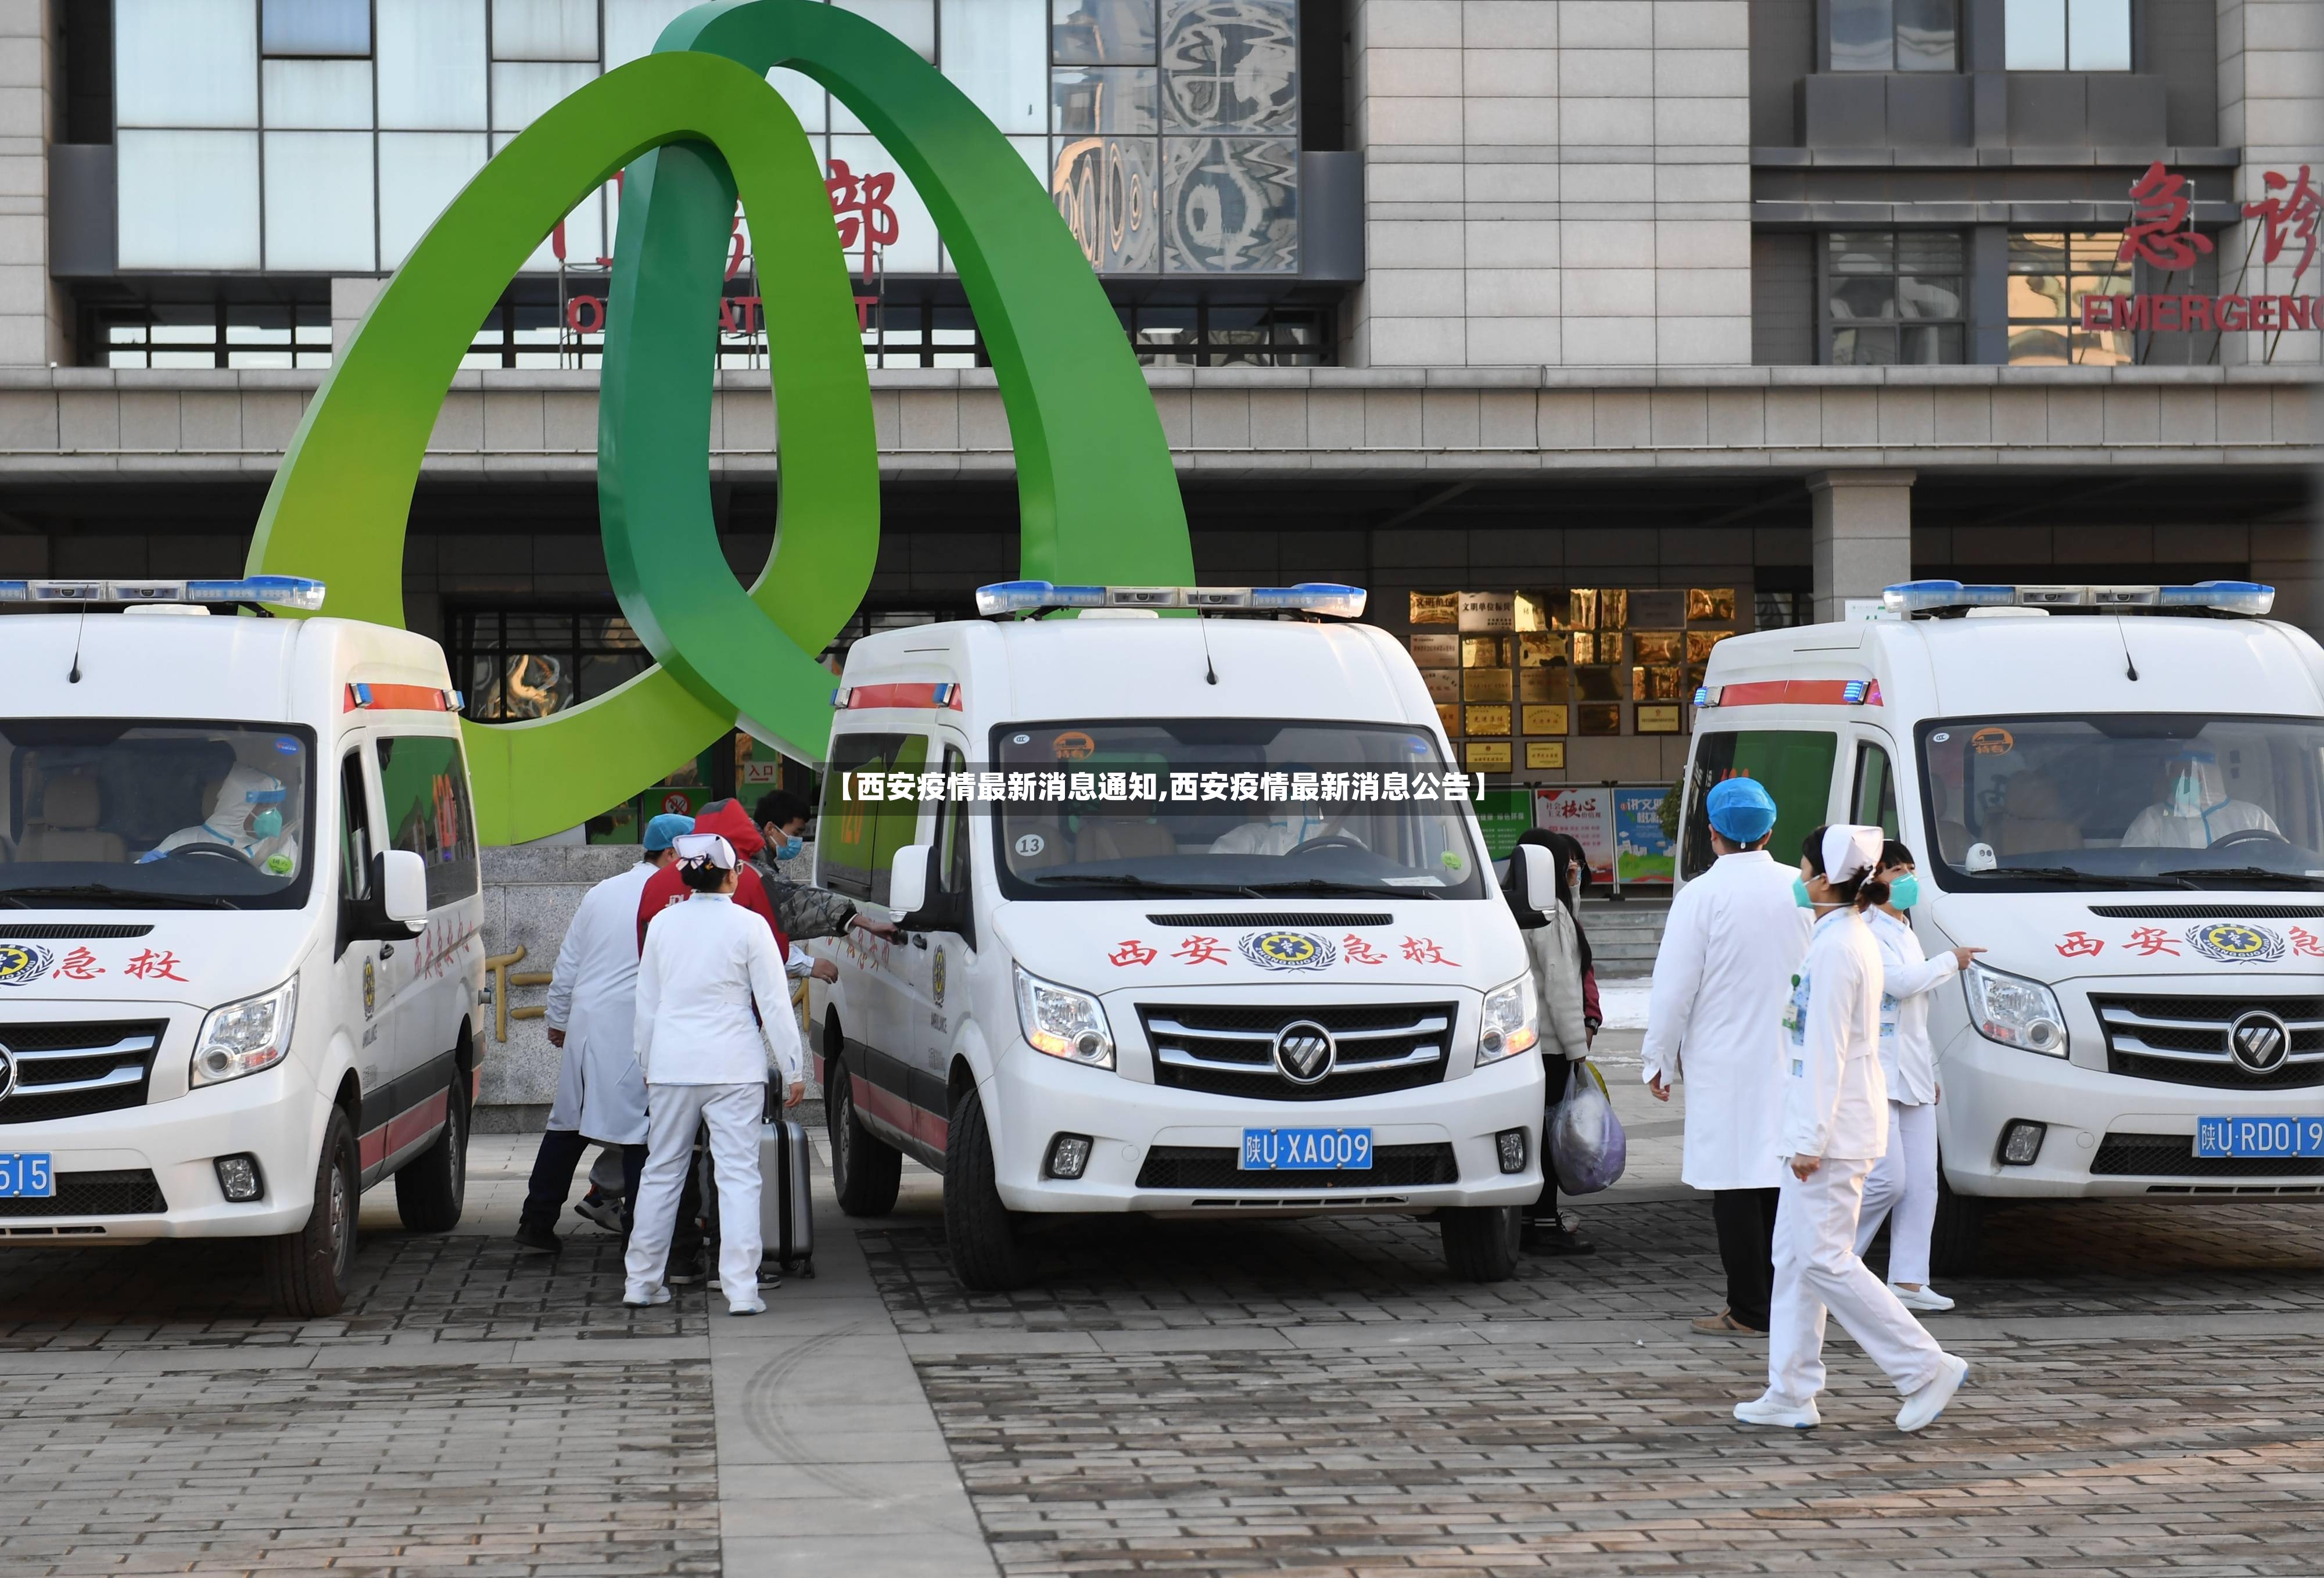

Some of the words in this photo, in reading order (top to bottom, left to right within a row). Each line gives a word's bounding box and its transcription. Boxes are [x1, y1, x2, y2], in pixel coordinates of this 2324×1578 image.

[2118, 160, 2324, 279] 急诊
[748, 765, 773, 777] 入口
[1561, 798, 1597, 819] 核心
[1020, 838, 1039, 853] 13
[1107, 935, 1232, 967] 西安
[1343, 933, 1463, 967] 急救
[2055, 926, 2183, 957] 西安
[52, 946, 190, 982] 急救
